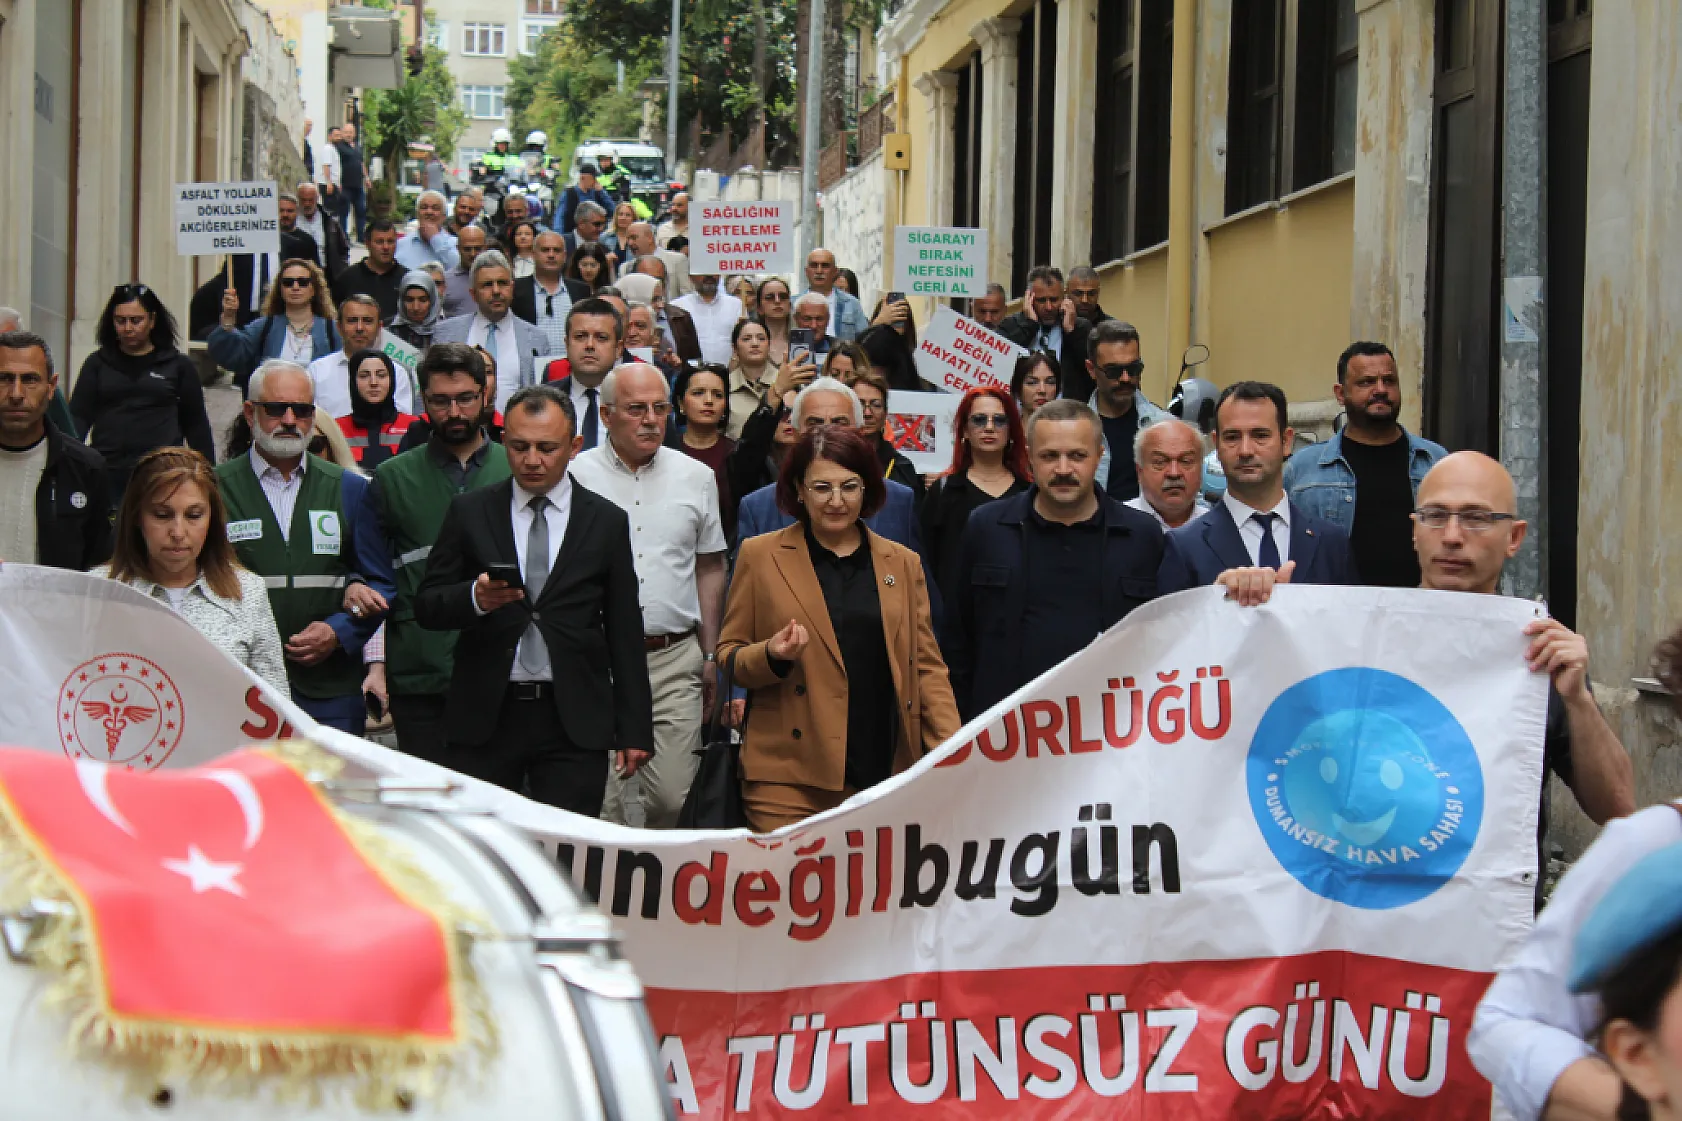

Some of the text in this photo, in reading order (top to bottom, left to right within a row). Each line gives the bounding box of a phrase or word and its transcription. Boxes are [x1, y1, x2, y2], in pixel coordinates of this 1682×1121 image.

[181, 188, 273, 200] ASFALT YOLLARA
[197, 203, 258, 216] DÖKÜLSÜN
[703, 205, 779, 219] SAĞLIĞINI
[180, 219, 277, 232] AKCİĞERLERİNİZE
[703, 224, 781, 236] ERTELEME
[213, 236, 245, 248] DEĞİL
[908, 230, 974, 245] SİGARAYI
[707, 240, 777, 253] SİGARAYI
[919, 249, 963, 260] BIRAK
[719, 259, 765, 270] BIRAK
[908, 264, 973, 278] NEFESİNİ
[913, 280, 969, 294] GERİ AL
[954, 318, 1011, 356] DUMANI
[921, 340, 971, 373] HAYATI
[953, 338, 993, 368] DEĞİL
[241, 685, 294, 741] S
[1265, 786, 1464, 864] DUMANSIZ HAVA SAHASI
[726, 992, 1199, 1113] TÜTÜNSÜZ
[1223, 981, 1450, 1098] GÜNÜ
